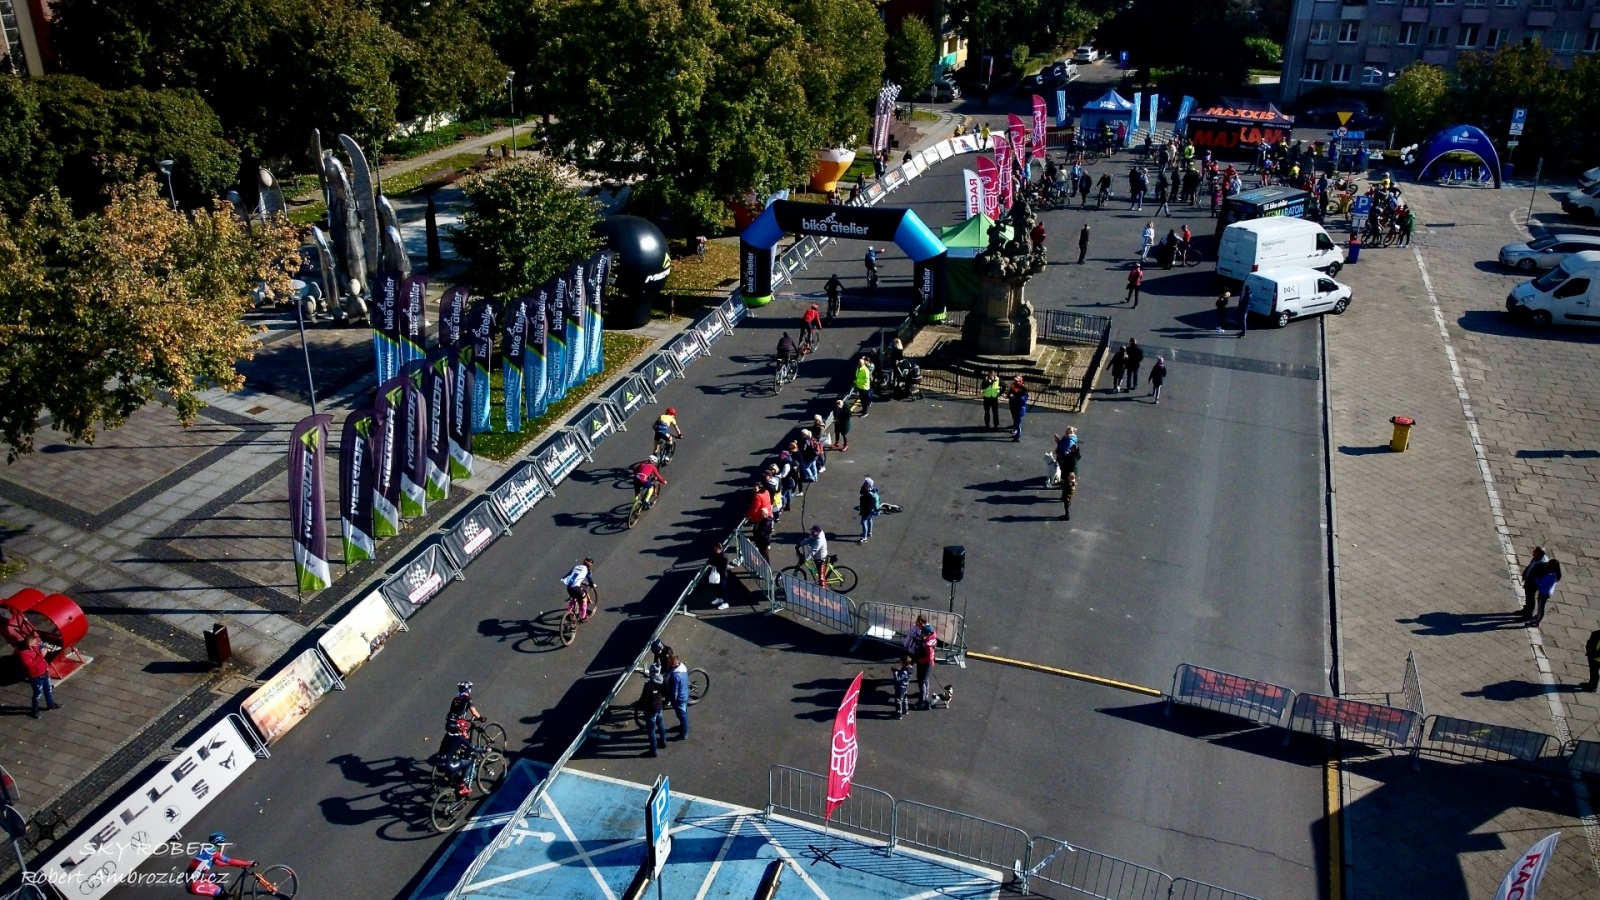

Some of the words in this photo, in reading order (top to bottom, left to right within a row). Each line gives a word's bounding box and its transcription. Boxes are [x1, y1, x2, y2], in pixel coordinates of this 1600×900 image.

[1206, 107, 1276, 120] MAXXIS
[1358, 197, 1369, 208] P
[802, 218, 828, 231] bike
[831, 221, 869, 235] atelier
[384, 277, 395, 307] atelier
[555, 278, 566, 308] atelier
[574, 265, 584, 294] atelier
[409, 282, 420, 312] atelier
[451, 291, 462, 323] atelier
[537, 290, 548, 322] atelier
[572, 295, 581, 316] bike
[384, 310, 394, 330] bike
[409, 315, 419, 336] bike
[481, 304, 493, 334] atelier
[515, 302, 528, 333] atelier
[553, 309, 562, 331] bike
[449, 325, 460, 345] ike
[510, 333, 521, 356] bike
[534, 323, 544, 345] bike
[431, 375, 442, 454] MERIDA
[456, 362, 466, 437] MERIDA
[477, 379, 485, 428] ROWEROWE
[407, 391, 417, 470] MERIDA
[382, 407, 396, 488] MERIDA
[350, 436, 365, 516] MERIDA
[303, 450, 313, 539] MERIDA
[59, 733, 227, 873] LELLEK
[656, 788, 666, 825] P
